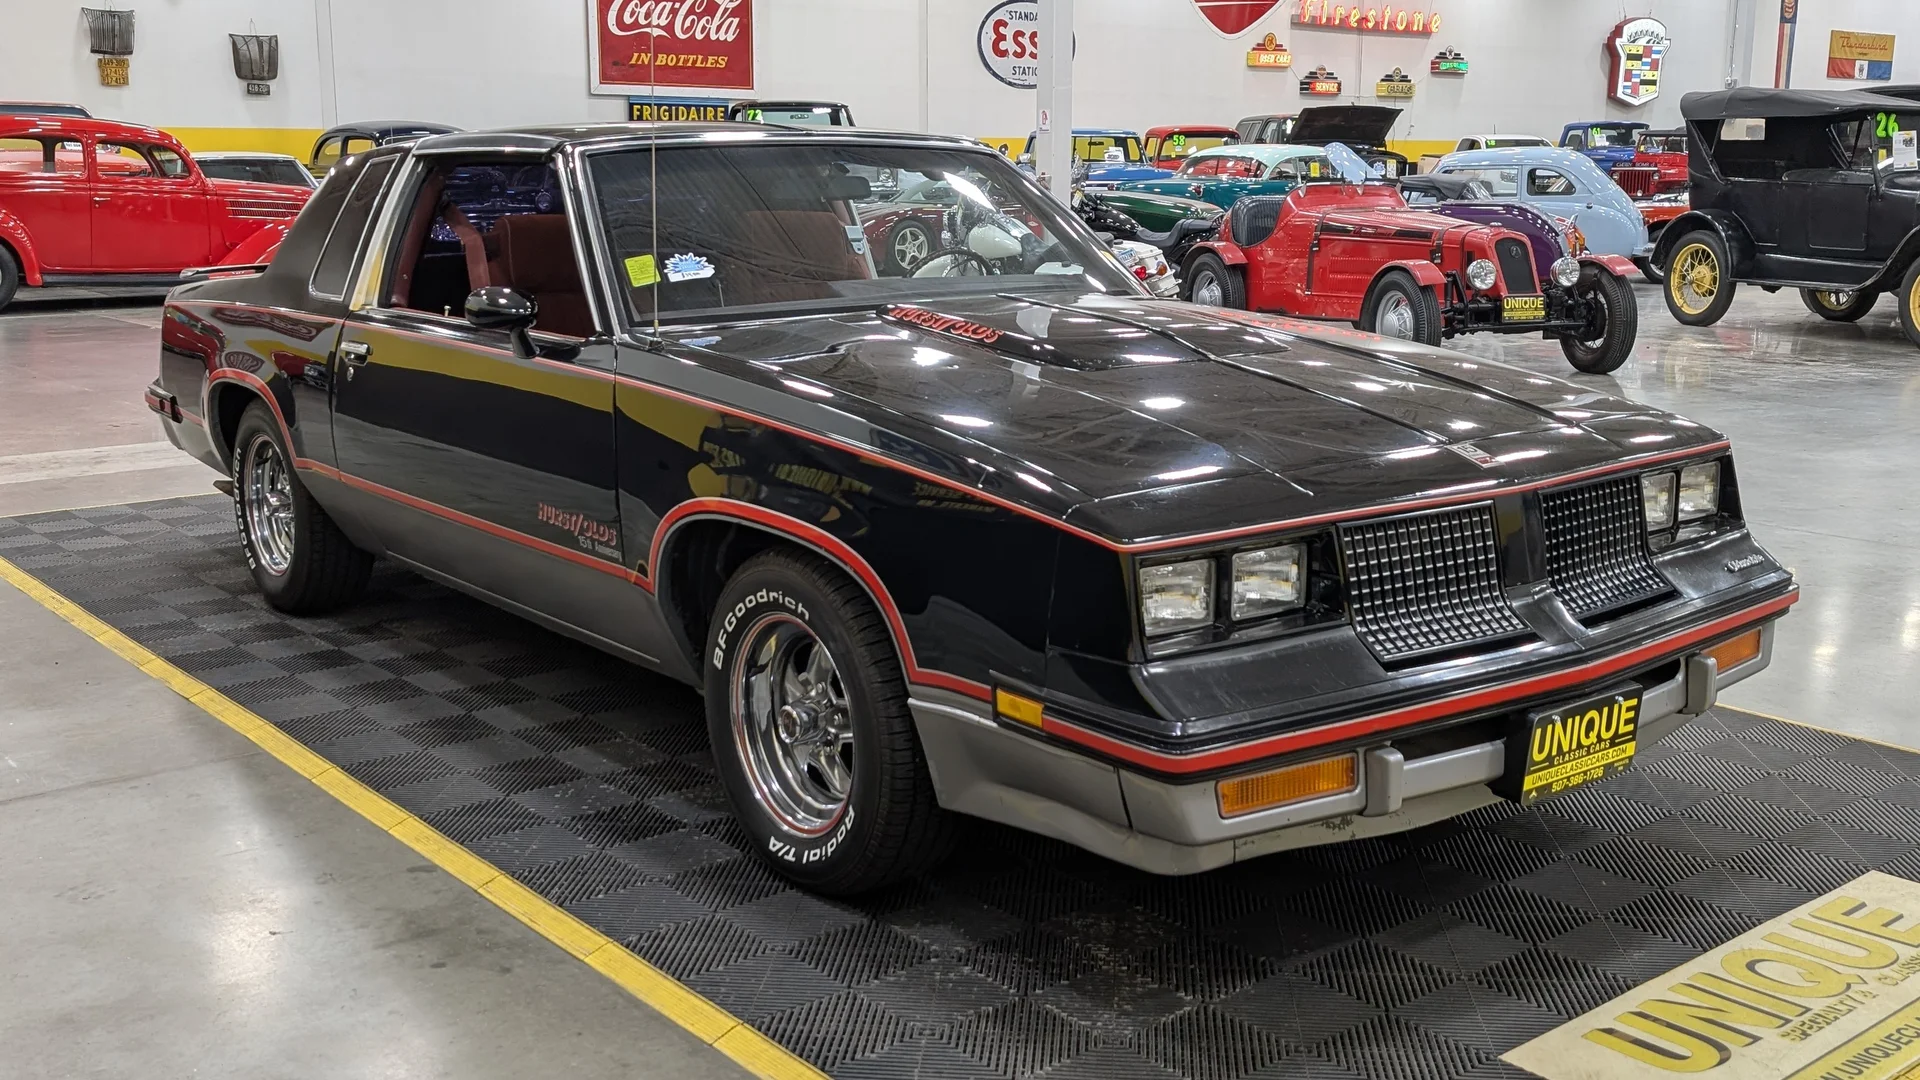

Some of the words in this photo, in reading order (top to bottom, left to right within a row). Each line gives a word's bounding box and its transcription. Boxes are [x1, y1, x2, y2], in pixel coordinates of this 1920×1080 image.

[607, 0, 741, 42] Coca-Cola
[1301, 0, 1442, 33] Firestone
[1839, 35, 1889, 52] Thunderbird
[629, 52, 652, 65] IN
[655, 54, 728, 69] BOTTLES
[632, 104, 726, 121] FRIGIDAIRE
[1876, 112, 1899, 138] 26
[1173, 134, 1186, 146] 58
[1504, 296, 1545, 309] UNIQUE
[536, 500, 618, 547] HURST/OLDS
[713, 587, 811, 671] BFGoodrich
[1532, 698, 1639, 762] UNIQUE
[1531, 745, 1628, 787] UNIQUECLASSICCARS.COM
[1553, 746, 1588, 765] CLASSIC
[1589, 739, 1611, 754] CARS
[1581, 896, 1920, 1073] UNIQUE
